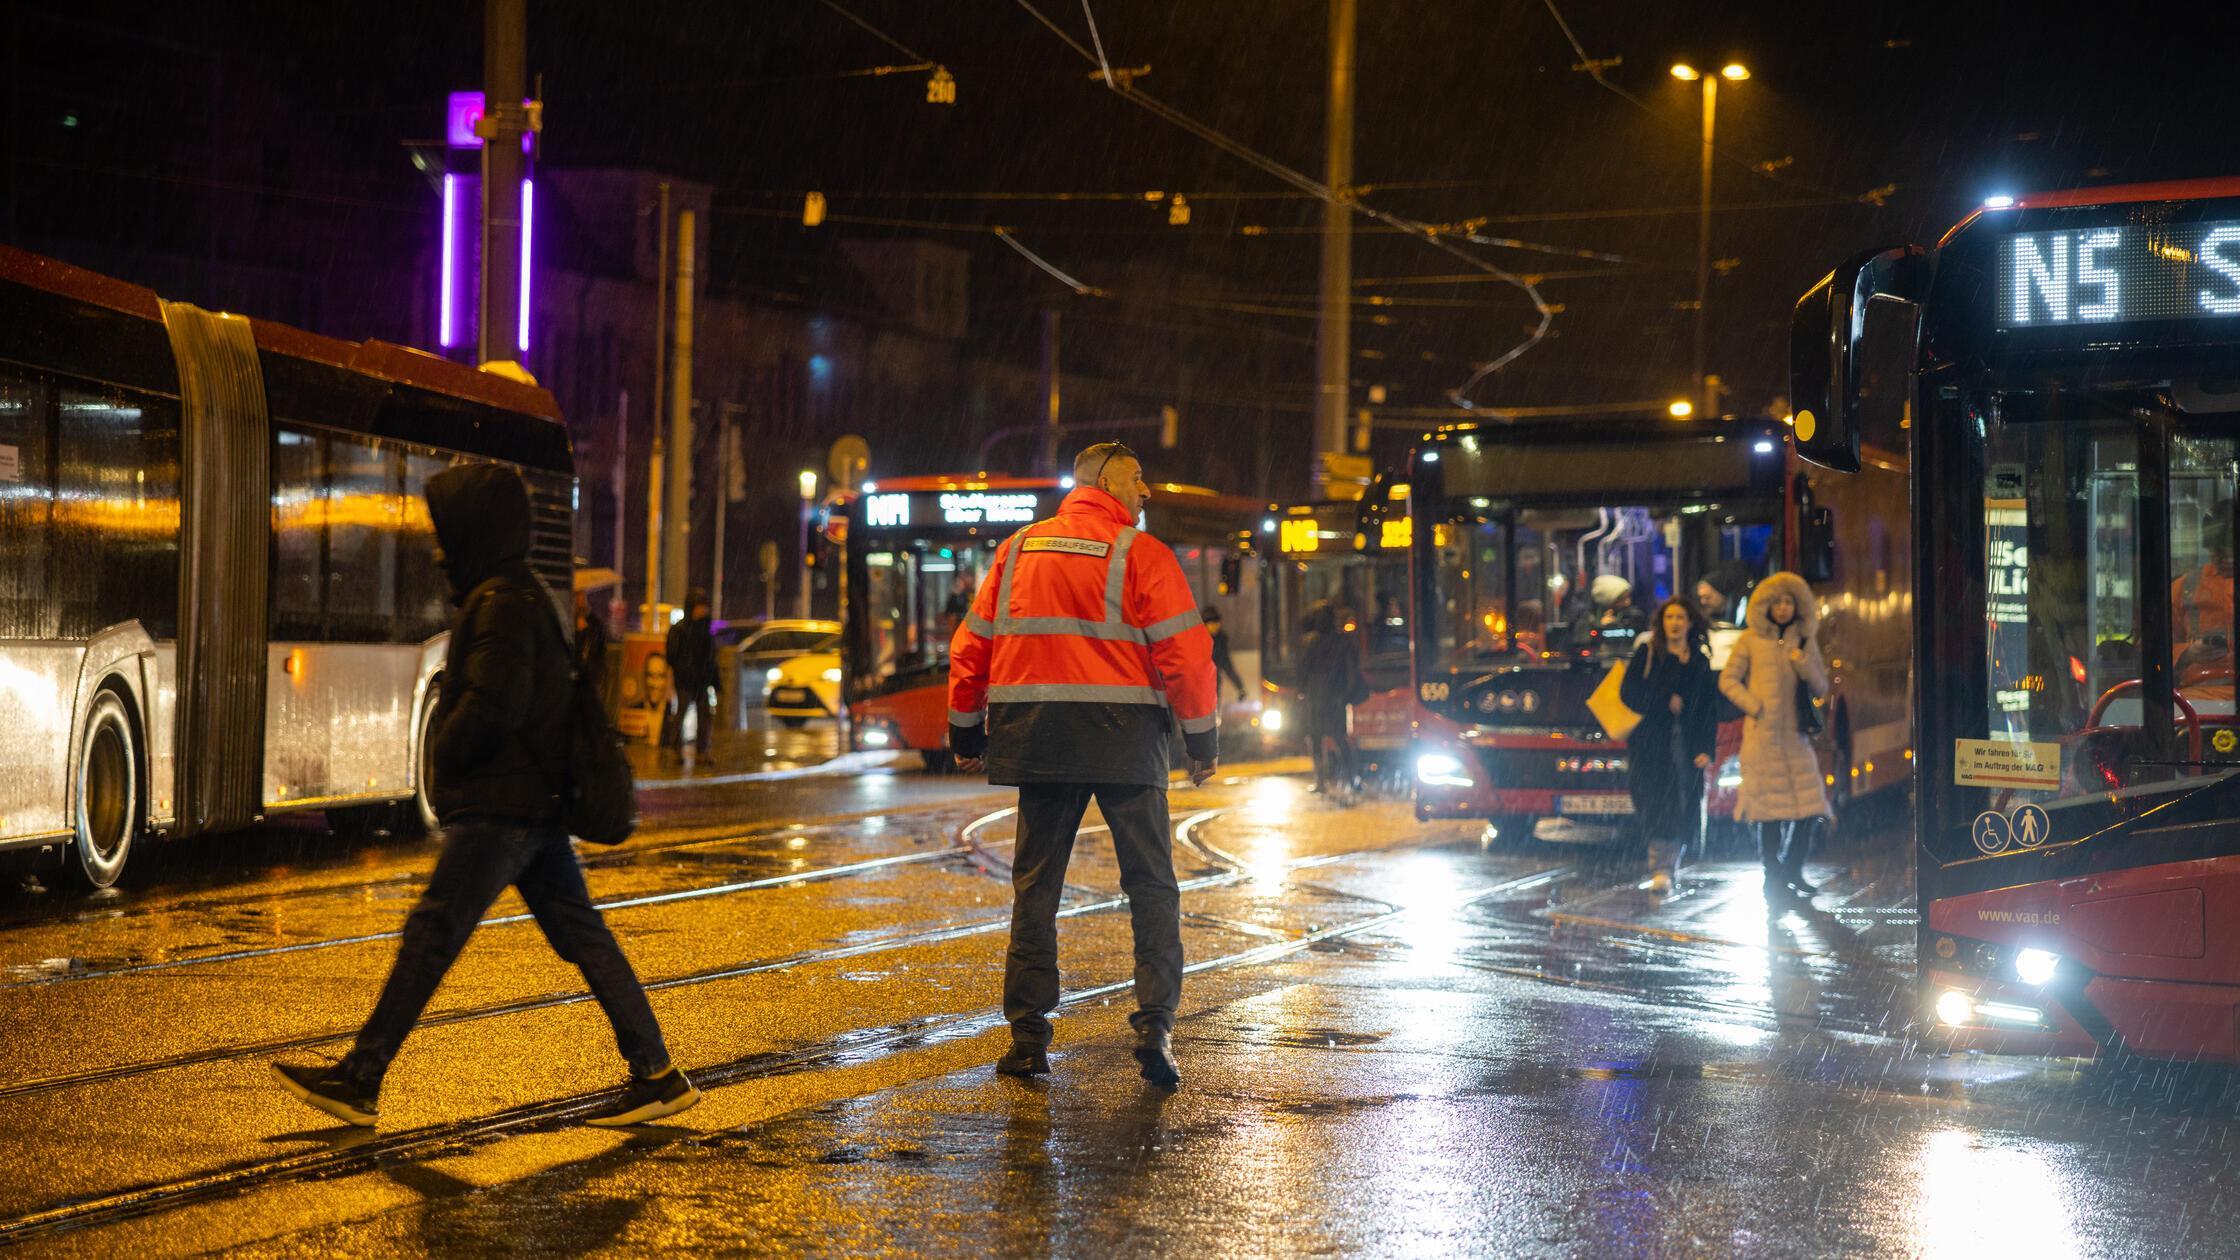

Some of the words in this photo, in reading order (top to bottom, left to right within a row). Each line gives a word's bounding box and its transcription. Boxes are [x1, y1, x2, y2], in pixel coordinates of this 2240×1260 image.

[2015, 233, 2119, 321] N5
[1025, 540, 1105, 553] BETRIEBSAUFSICHT
[1974, 747, 1986, 756] Wir
[1988, 748, 2010, 758] fahren
[1973, 761, 1983, 769] im
[1985, 761, 2010, 772] Auftrag
[2011, 763, 2023, 771] der
[2025, 763, 2044, 772] VAG
[1978, 910, 2060, 927] www.vag.de
